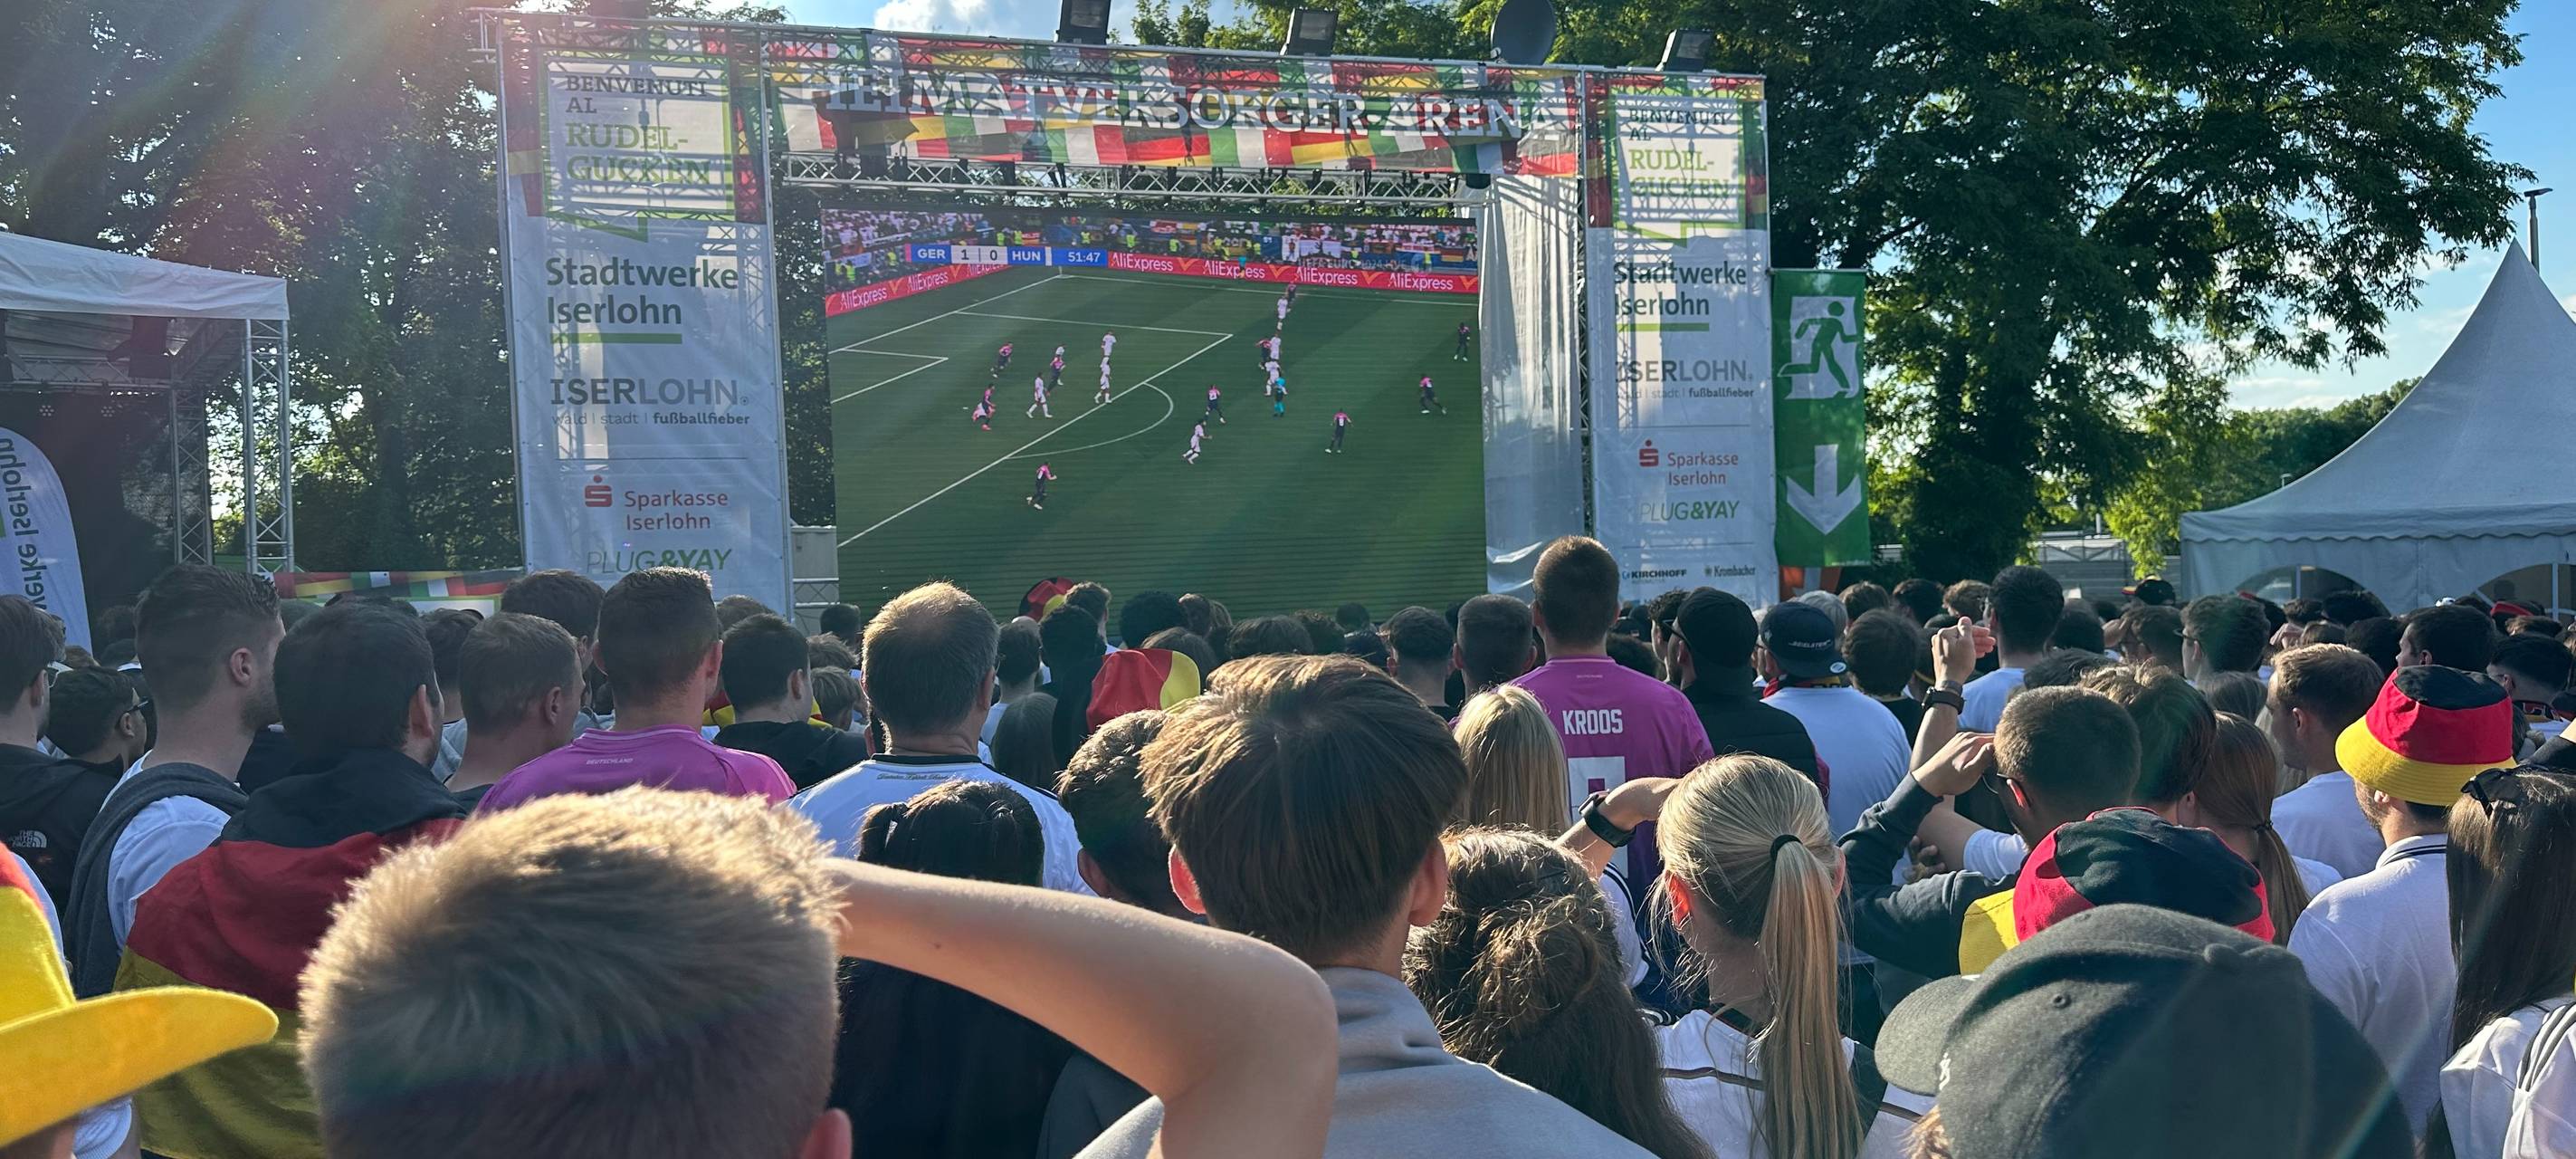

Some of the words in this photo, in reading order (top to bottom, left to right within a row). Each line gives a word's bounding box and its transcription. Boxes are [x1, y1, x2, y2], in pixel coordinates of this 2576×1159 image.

[565, 75, 708, 97] BENVENUTI
[566, 97, 596, 114] AL
[1380, 94, 1568, 139] ARENA
[1629, 109, 1727, 125] BENVENUTI
[565, 122, 688, 151] RUDEL-
[1629, 128, 1651, 141] AL
[1629, 149, 1714, 171] RUDEL-
[567, 156, 711, 186] GUCKEN
[917, 248, 946, 259] GER
[961, 249, 969, 260] 1
[989, 250, 998, 261] 0
[1012, 250, 1041, 262] HUN
[1068, 251, 1101, 263] 51:47
[1111, 253, 1174, 272] AliExpress
[546, 257, 739, 290] Stadtwerke
[1203, 260, 1265, 279] AliExpess
[1295, 267, 1358, 285] AliExpress
[1614, 261, 1747, 285] Stadtwerke
[907, 272, 949, 292] AliExpress
[1388, 273, 1454, 292] AliExpress
[548, 294, 682, 324] Iserlohn
[840, 287, 887, 311] AliExpress
[1615, 292, 1710, 315] Iserlohn
[1689, 388, 1754, 398] fußballfieber
[551, 412, 587, 425] wald
[601, 413, 638, 425] stadt
[654, 412, 750, 425] fußballfieber
[1667, 452, 1738, 469] Sparkasse
[1669, 472, 1726, 485] Iserlohn
[625, 490, 728, 511] Sparkasse
[1639, 501, 1740, 522] PLUG&YAY
[627, 513, 711, 531] Iserlohn
[586, 549, 732, 574] PLUG&YAY
[1562, 709, 1623, 735] KROOS
